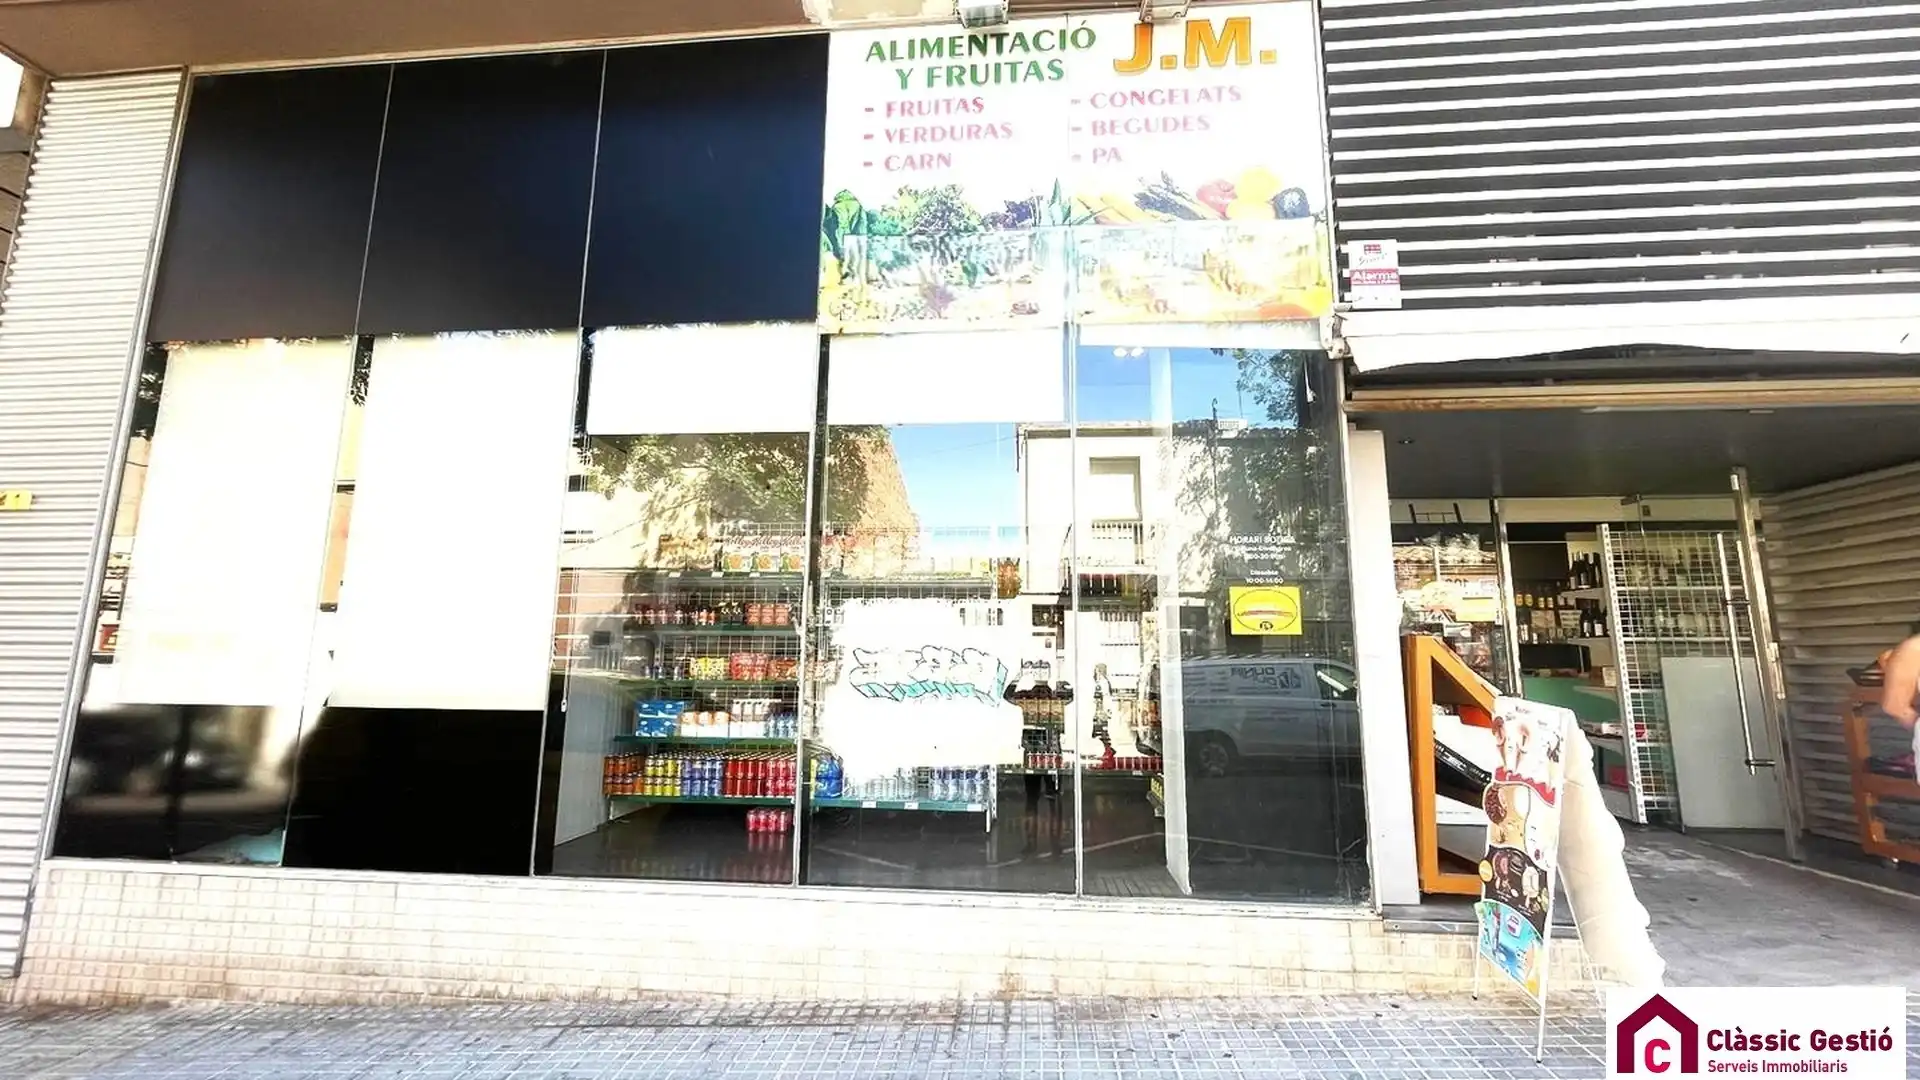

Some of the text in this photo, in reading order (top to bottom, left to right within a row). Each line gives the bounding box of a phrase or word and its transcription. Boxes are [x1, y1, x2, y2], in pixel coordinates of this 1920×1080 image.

[865, 20, 1097, 64] ALIMENTACIÓ
[1113, 16, 1278, 75] J.M.
[895, 58, 1065, 91] Y FRUITAS
[885, 96, 985, 119] FRUITAS
[1090, 85, 1242, 109] CONGELATS
[885, 122, 1013, 144] VERDURAS
[1091, 115, 1211, 136] BEGUDES
[885, 152, 952, 172] CARN
[1092, 146, 1123, 165] PA
